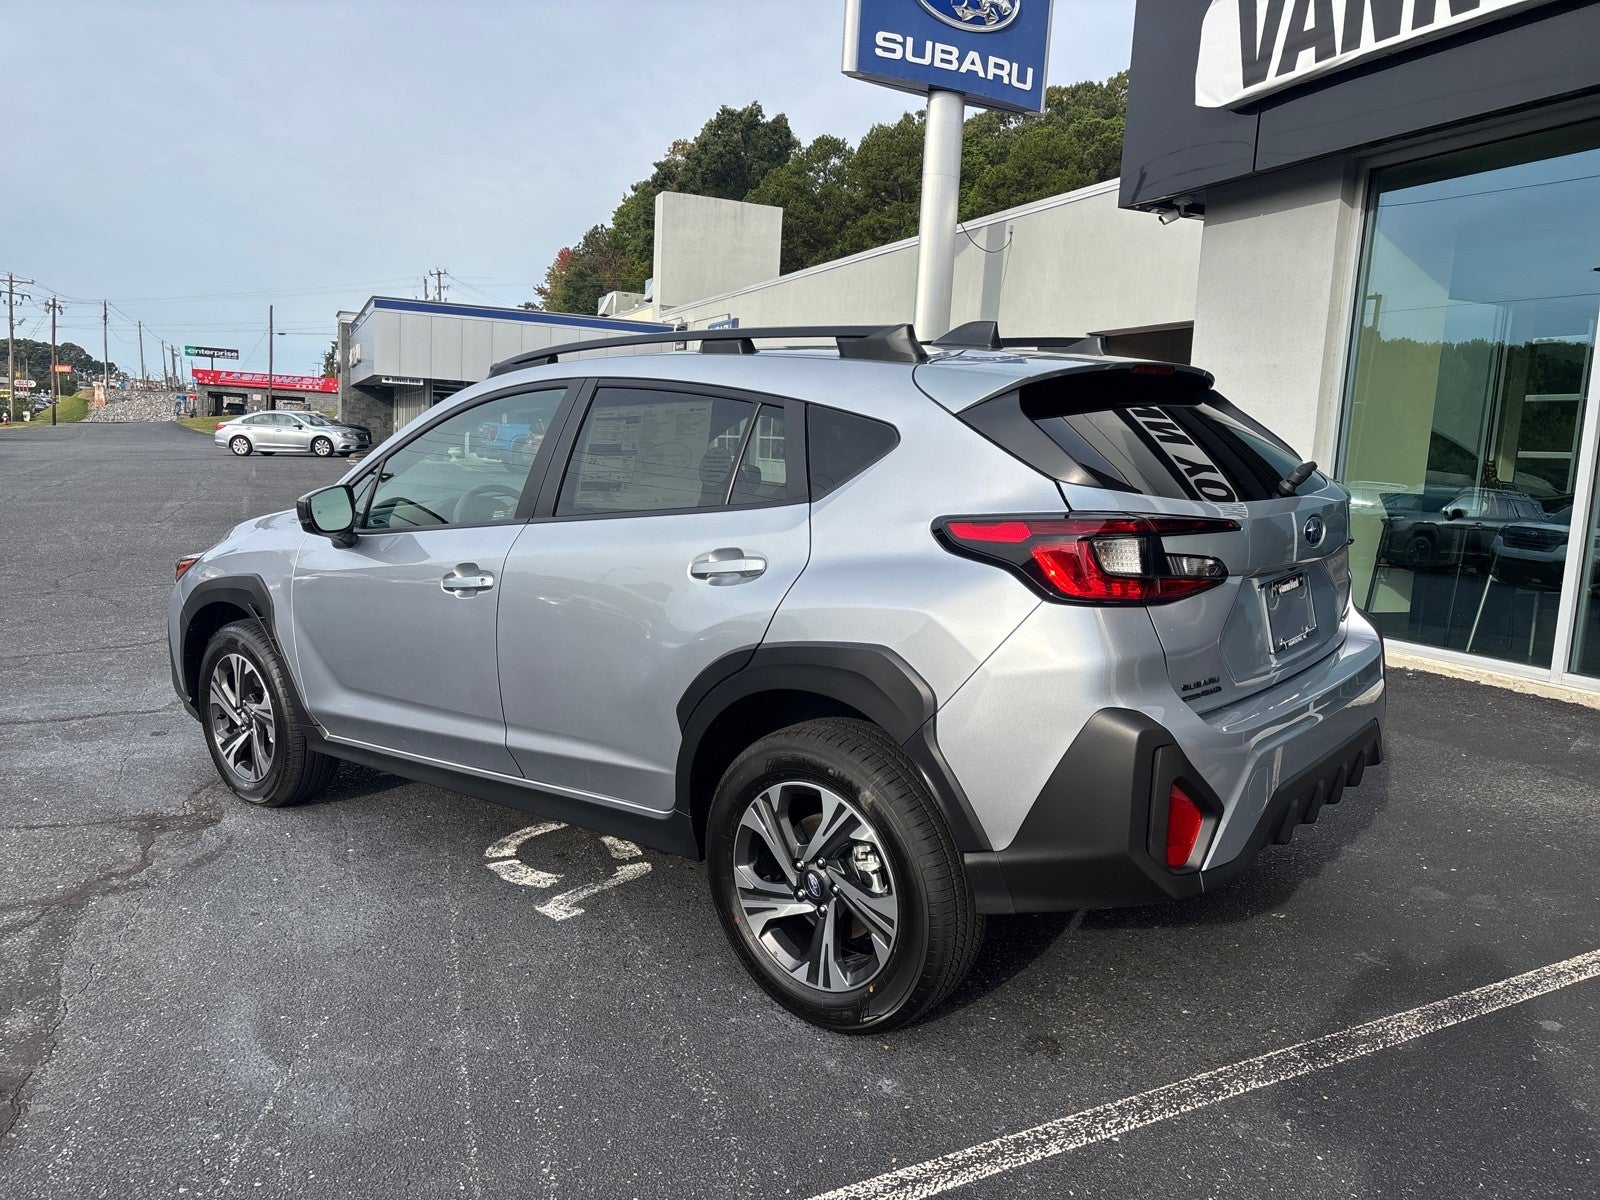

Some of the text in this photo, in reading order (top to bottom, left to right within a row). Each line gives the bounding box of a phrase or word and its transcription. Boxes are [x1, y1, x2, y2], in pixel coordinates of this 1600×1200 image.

[1239, 0, 1480, 89] VA
[875, 31, 1034, 91] SUBARU
[187, 347, 238, 357] enterprise
[219, 371, 326, 385] LASERWASH
[1181, 675, 1221, 691] SUBARU
